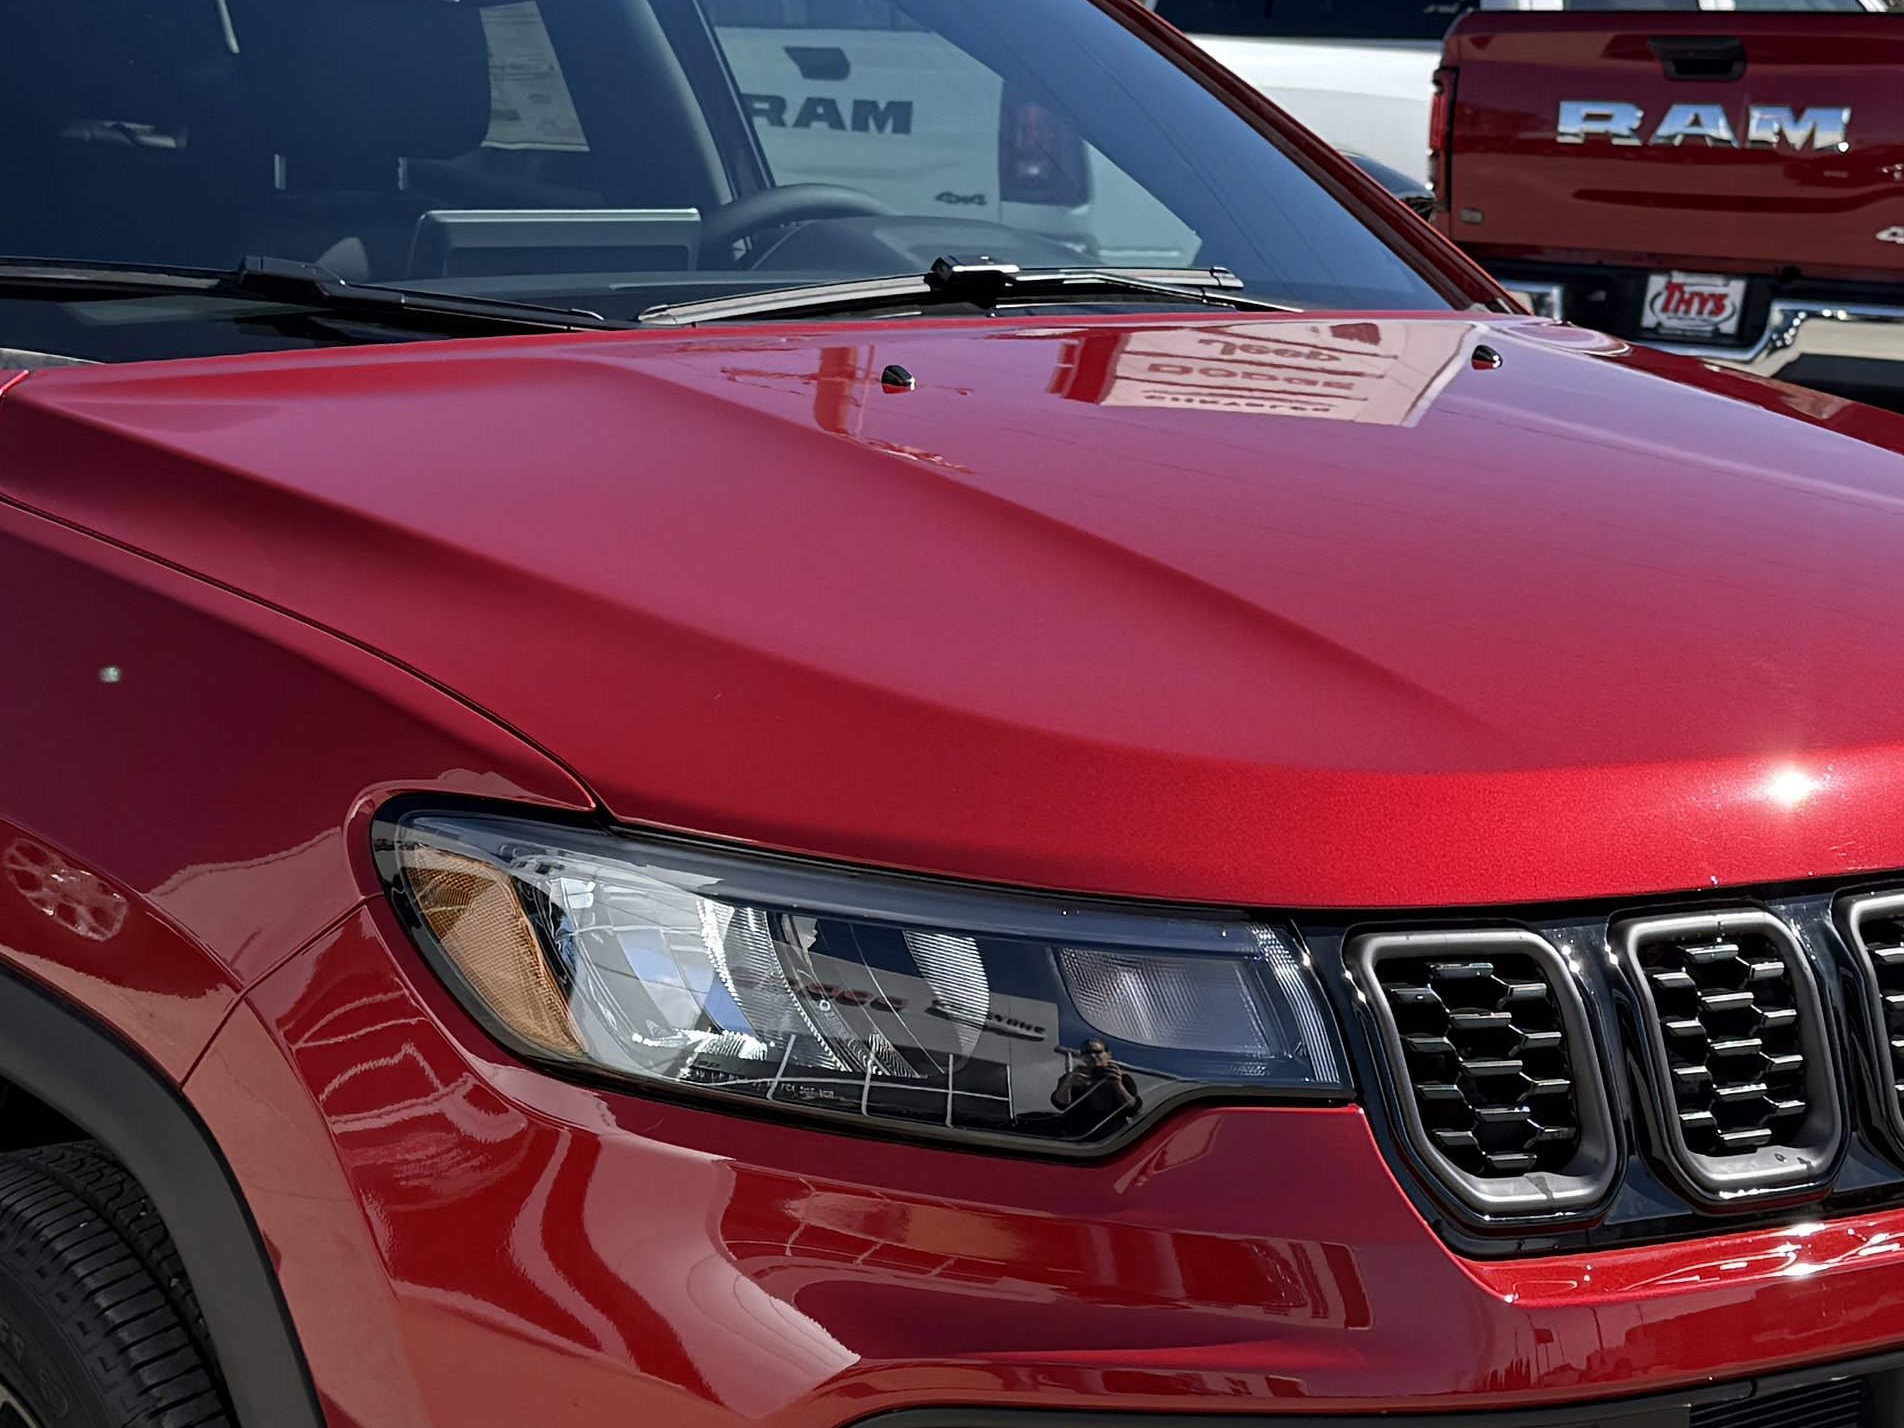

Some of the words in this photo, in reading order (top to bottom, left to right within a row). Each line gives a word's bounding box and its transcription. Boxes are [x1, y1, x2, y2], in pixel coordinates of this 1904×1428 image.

[741, 93, 914, 135] RAM
[1555, 99, 1852, 154] RAM
[1661, 281, 1729, 317] THYS
